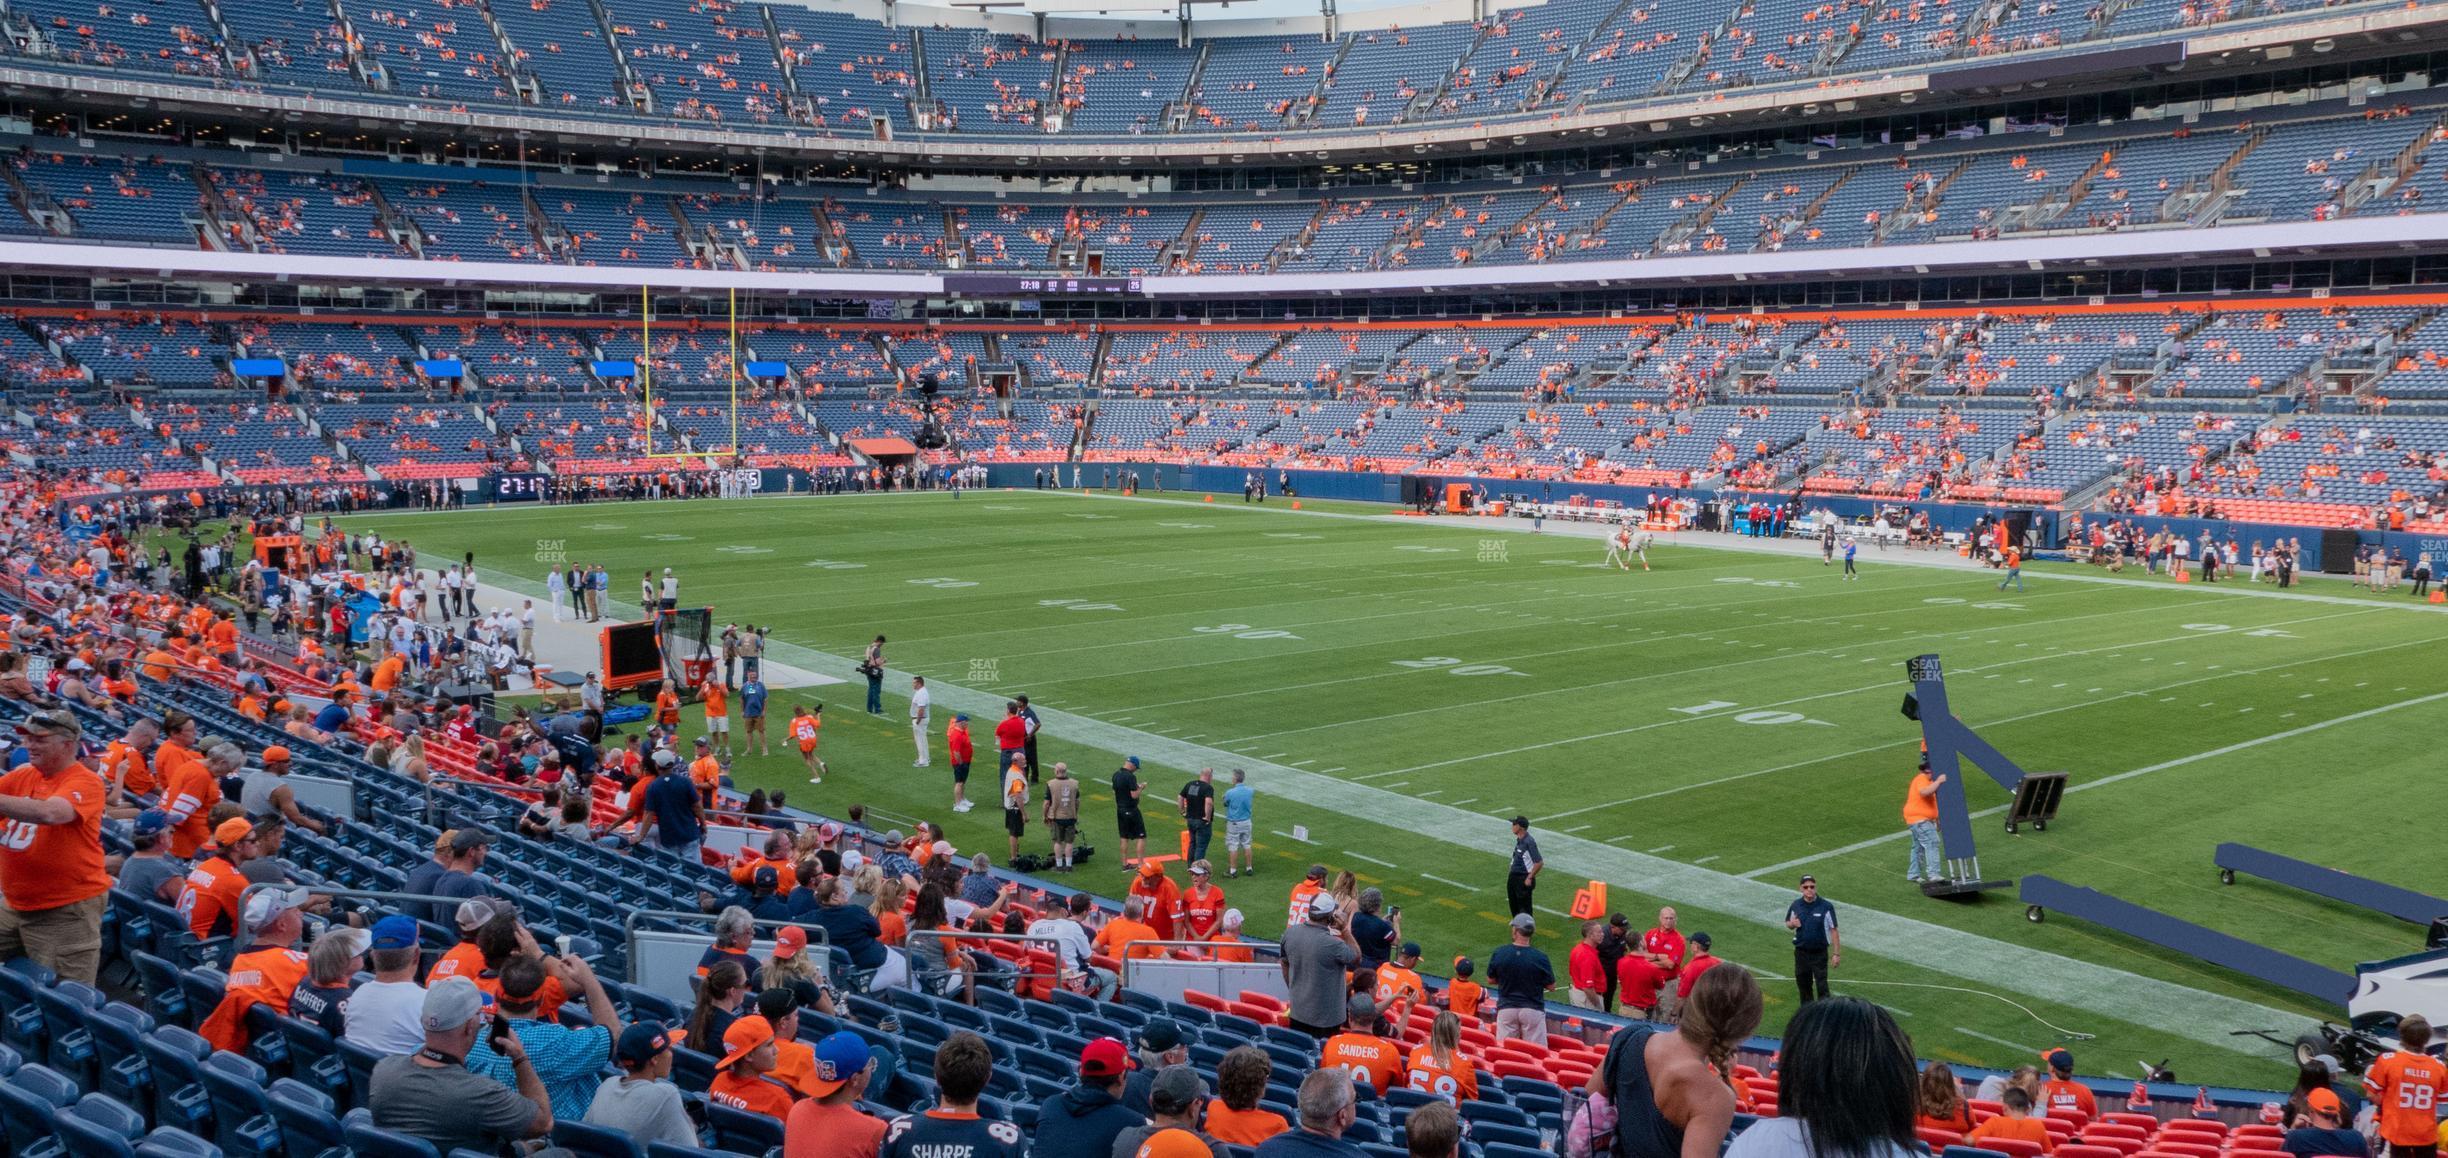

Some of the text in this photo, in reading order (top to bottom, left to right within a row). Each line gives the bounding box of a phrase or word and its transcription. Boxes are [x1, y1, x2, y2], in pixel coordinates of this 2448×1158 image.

[1020, 281, 1040, 290] 27:18
[1130, 281, 1140, 290] 25
[906, 577, 980, 588] 50
[1039, 599, 1117, 611] 40
[1192, 624, 1291, 639] 30
[688, 664, 701, 679] G
[1390, 656, 1513, 676] 20
[1669, 701, 1806, 725] 10
[797, 724, 816, 740] 58
[1190, 908, 1213, 916] BRONCOS
[1575, 894, 1591, 915] G
[1035, 926, 1056, 935] MILLER
[1337, 1043, 1380, 1059] SANDERS
[2404, 1067, 2430, 1079] MILLER
[1410, 1070, 1457, 1108] 58
[2399, 1083, 2434, 1110] 58
[713, 1090, 748, 1110] MILLER
[2053, 1095, 2077, 1104] ELWAY
[911, 1144, 975, 1158] SHARPE
